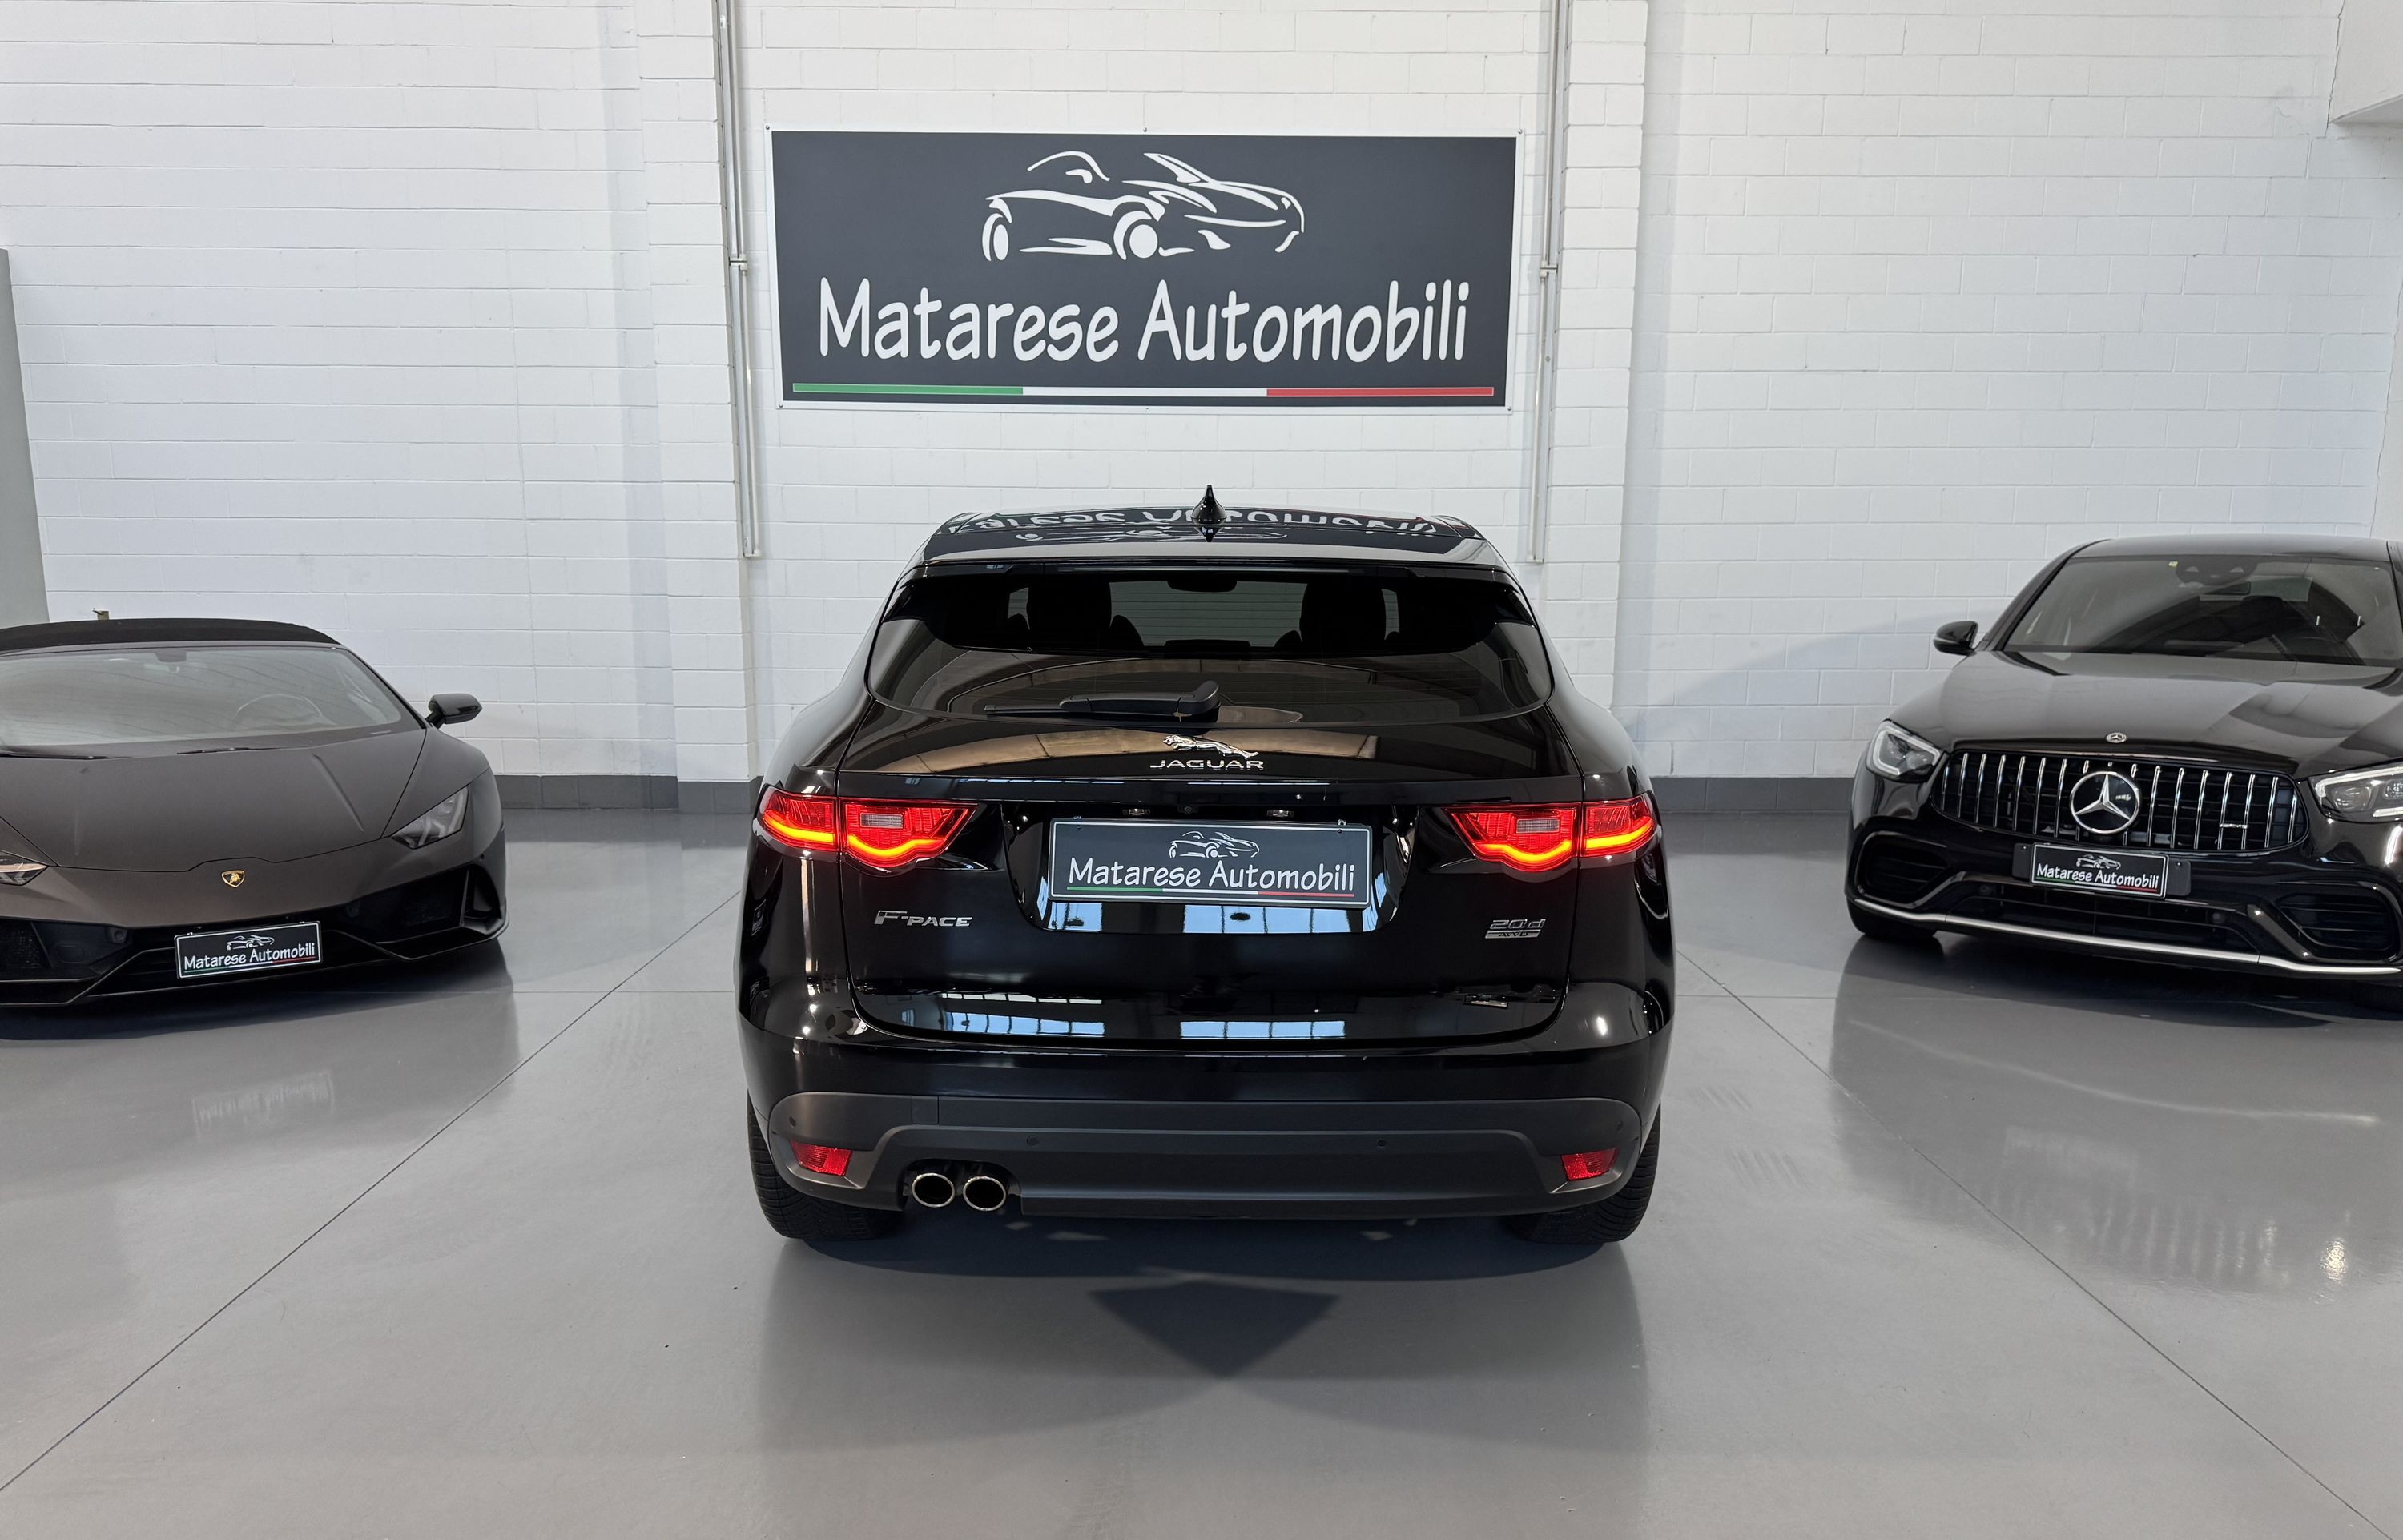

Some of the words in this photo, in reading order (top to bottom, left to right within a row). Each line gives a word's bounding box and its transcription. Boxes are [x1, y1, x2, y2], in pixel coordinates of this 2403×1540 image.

[819, 277, 1119, 363] Matarese
[1137, 279, 1469, 363] Automobili
[1149, 759, 1265, 771] JAGUAR
[1069, 857, 1201, 887] Matarese
[1208, 860, 1355, 891] Automobili
[2036, 862, 2093, 882] Matarese
[2095, 869, 2159, 889] Automobili
[874, 910, 972, 927] F-PACE
[1490, 918, 1546, 929] 20d
[183, 954, 247, 971] Matarese
[249, 942, 316, 963] Automobili
